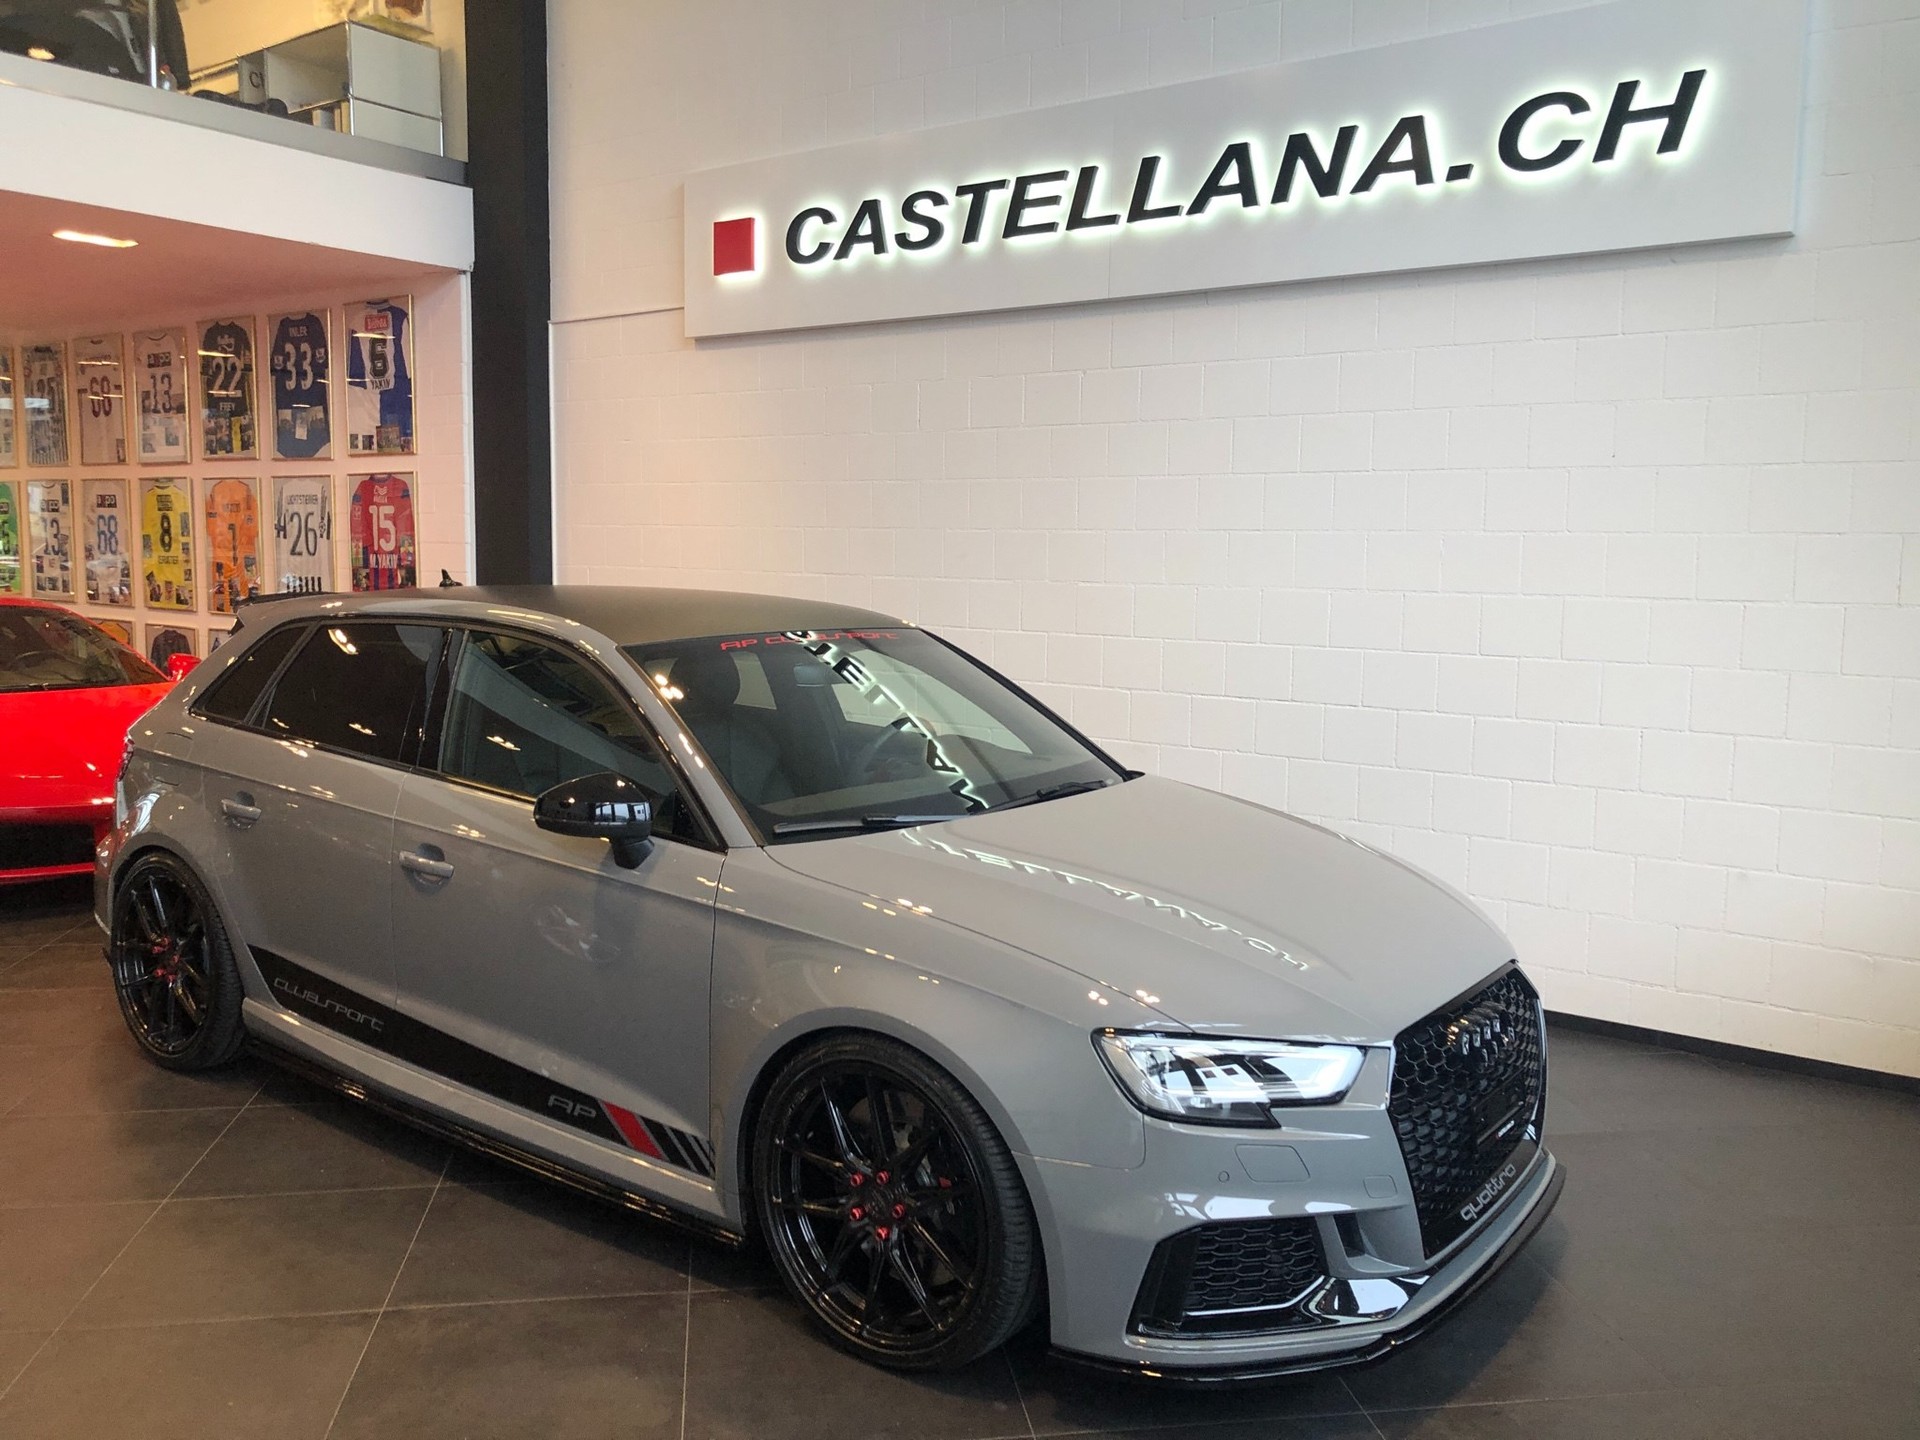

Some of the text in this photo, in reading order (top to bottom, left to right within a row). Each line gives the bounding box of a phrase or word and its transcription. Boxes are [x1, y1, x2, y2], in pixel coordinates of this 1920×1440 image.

[284, 342, 314, 391] 33
[369, 332, 390, 379] 6
[150, 371, 173, 414] 13
[211, 357, 242, 398] 22
[42, 516, 61, 556] 13
[96, 514, 119, 556] 68
[160, 512, 173, 553] 8
[289, 510, 318, 557] 26
[368, 505, 398, 552] 15
[720, 638, 758, 651] AP
[547, 1094, 597, 1118] AP
[1460, 1163, 1517, 1221] quattro
